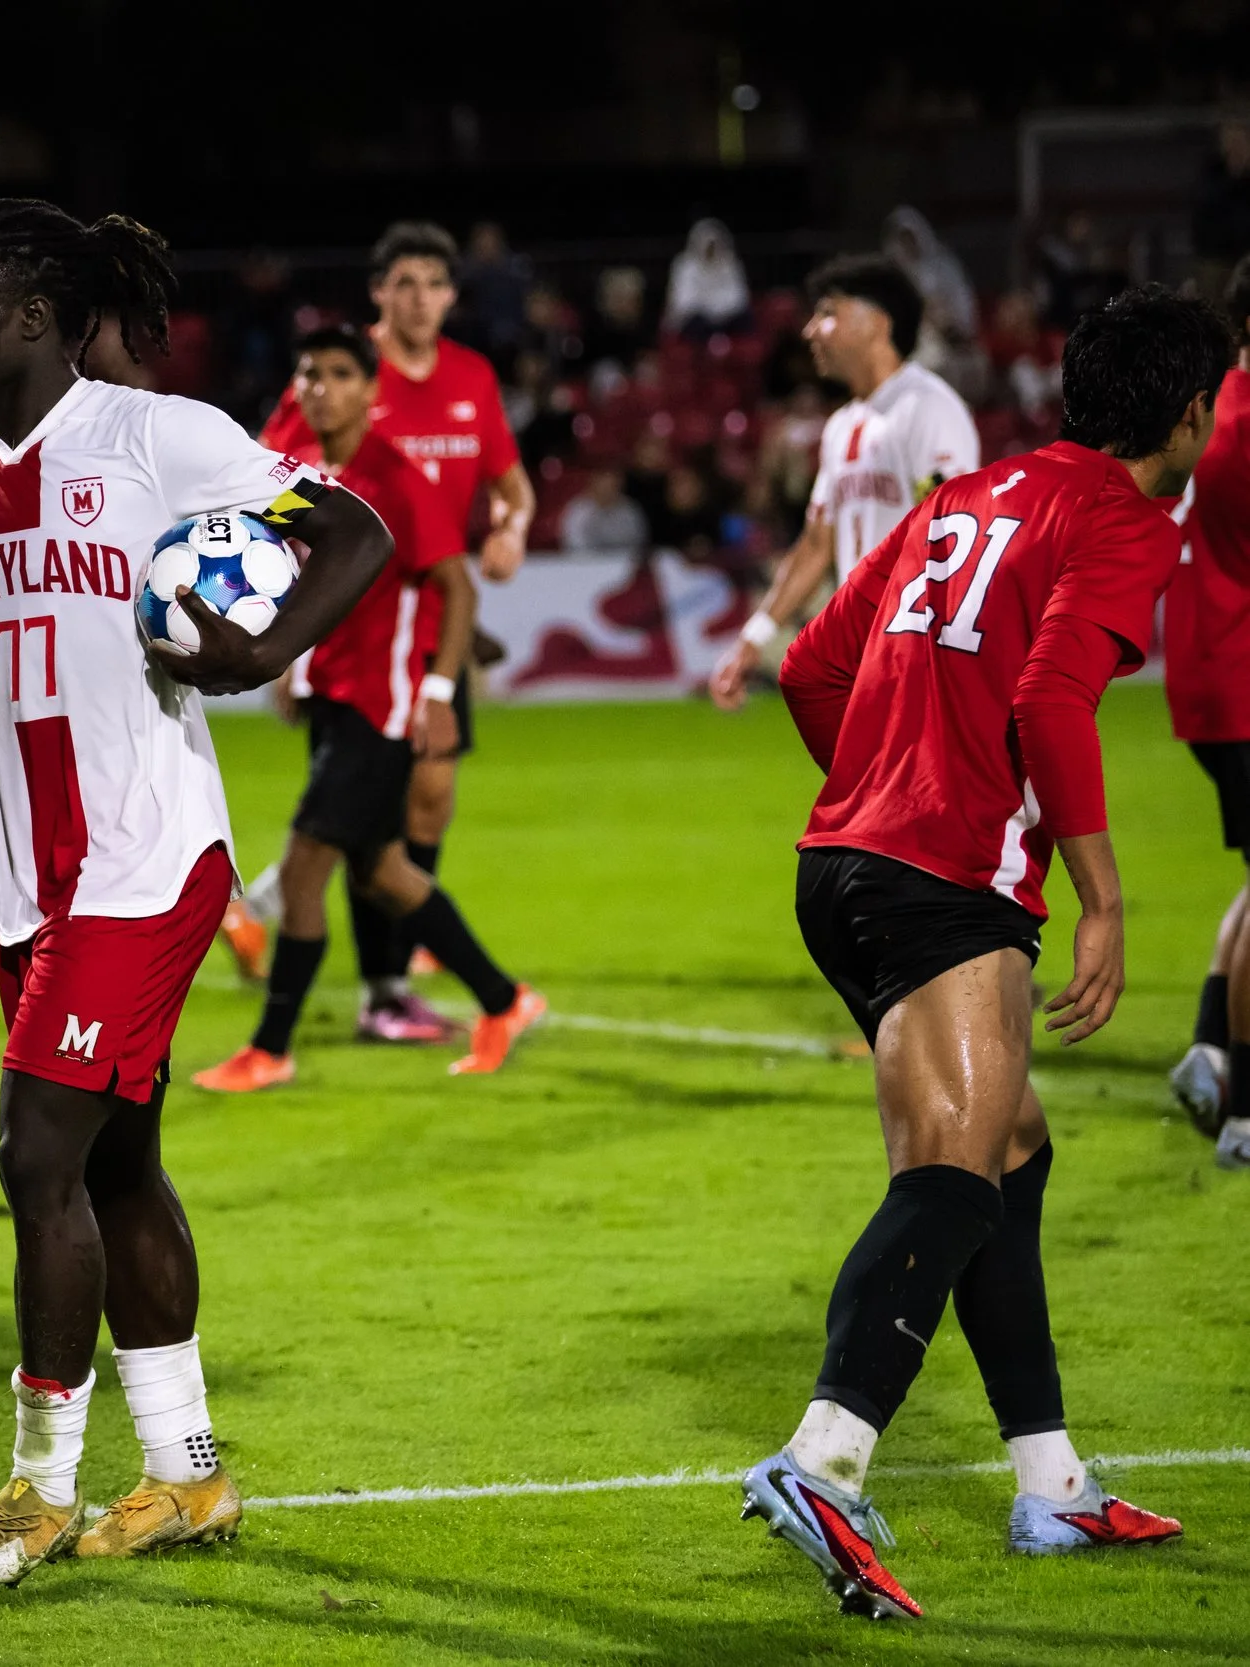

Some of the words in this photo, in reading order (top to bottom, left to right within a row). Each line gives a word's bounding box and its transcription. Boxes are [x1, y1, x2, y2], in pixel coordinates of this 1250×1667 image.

[72, 490, 94, 514] M
[884, 511, 1023, 654] 21
[57, 1013, 103, 1059] M
